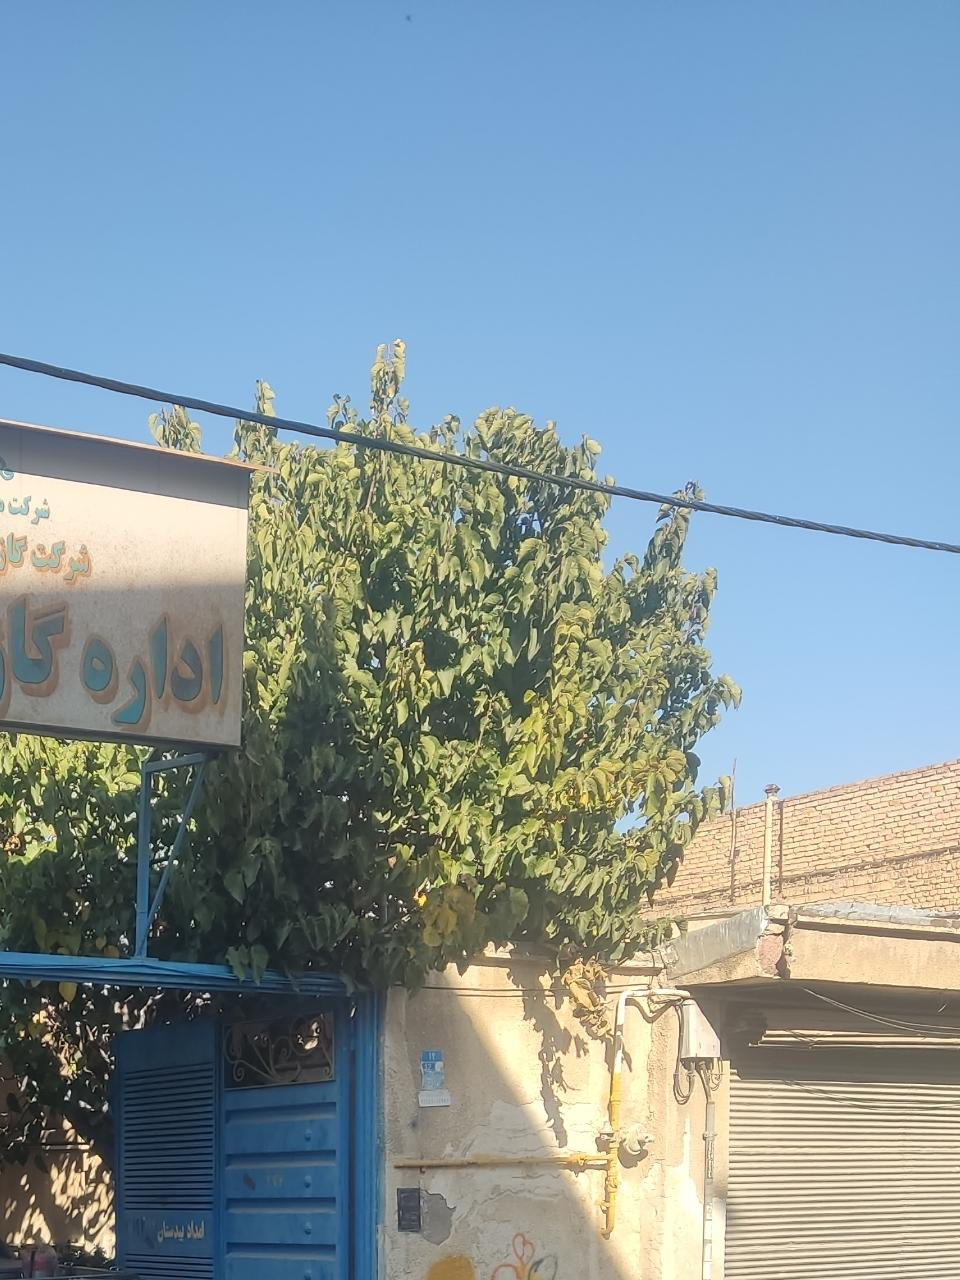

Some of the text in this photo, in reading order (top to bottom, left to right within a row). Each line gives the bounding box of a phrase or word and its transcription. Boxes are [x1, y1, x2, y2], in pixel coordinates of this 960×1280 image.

[8, 496, 50, 525] شرکت
[31, 541, 91, 582] شرکت
[81, 615, 226, 726] اداره
